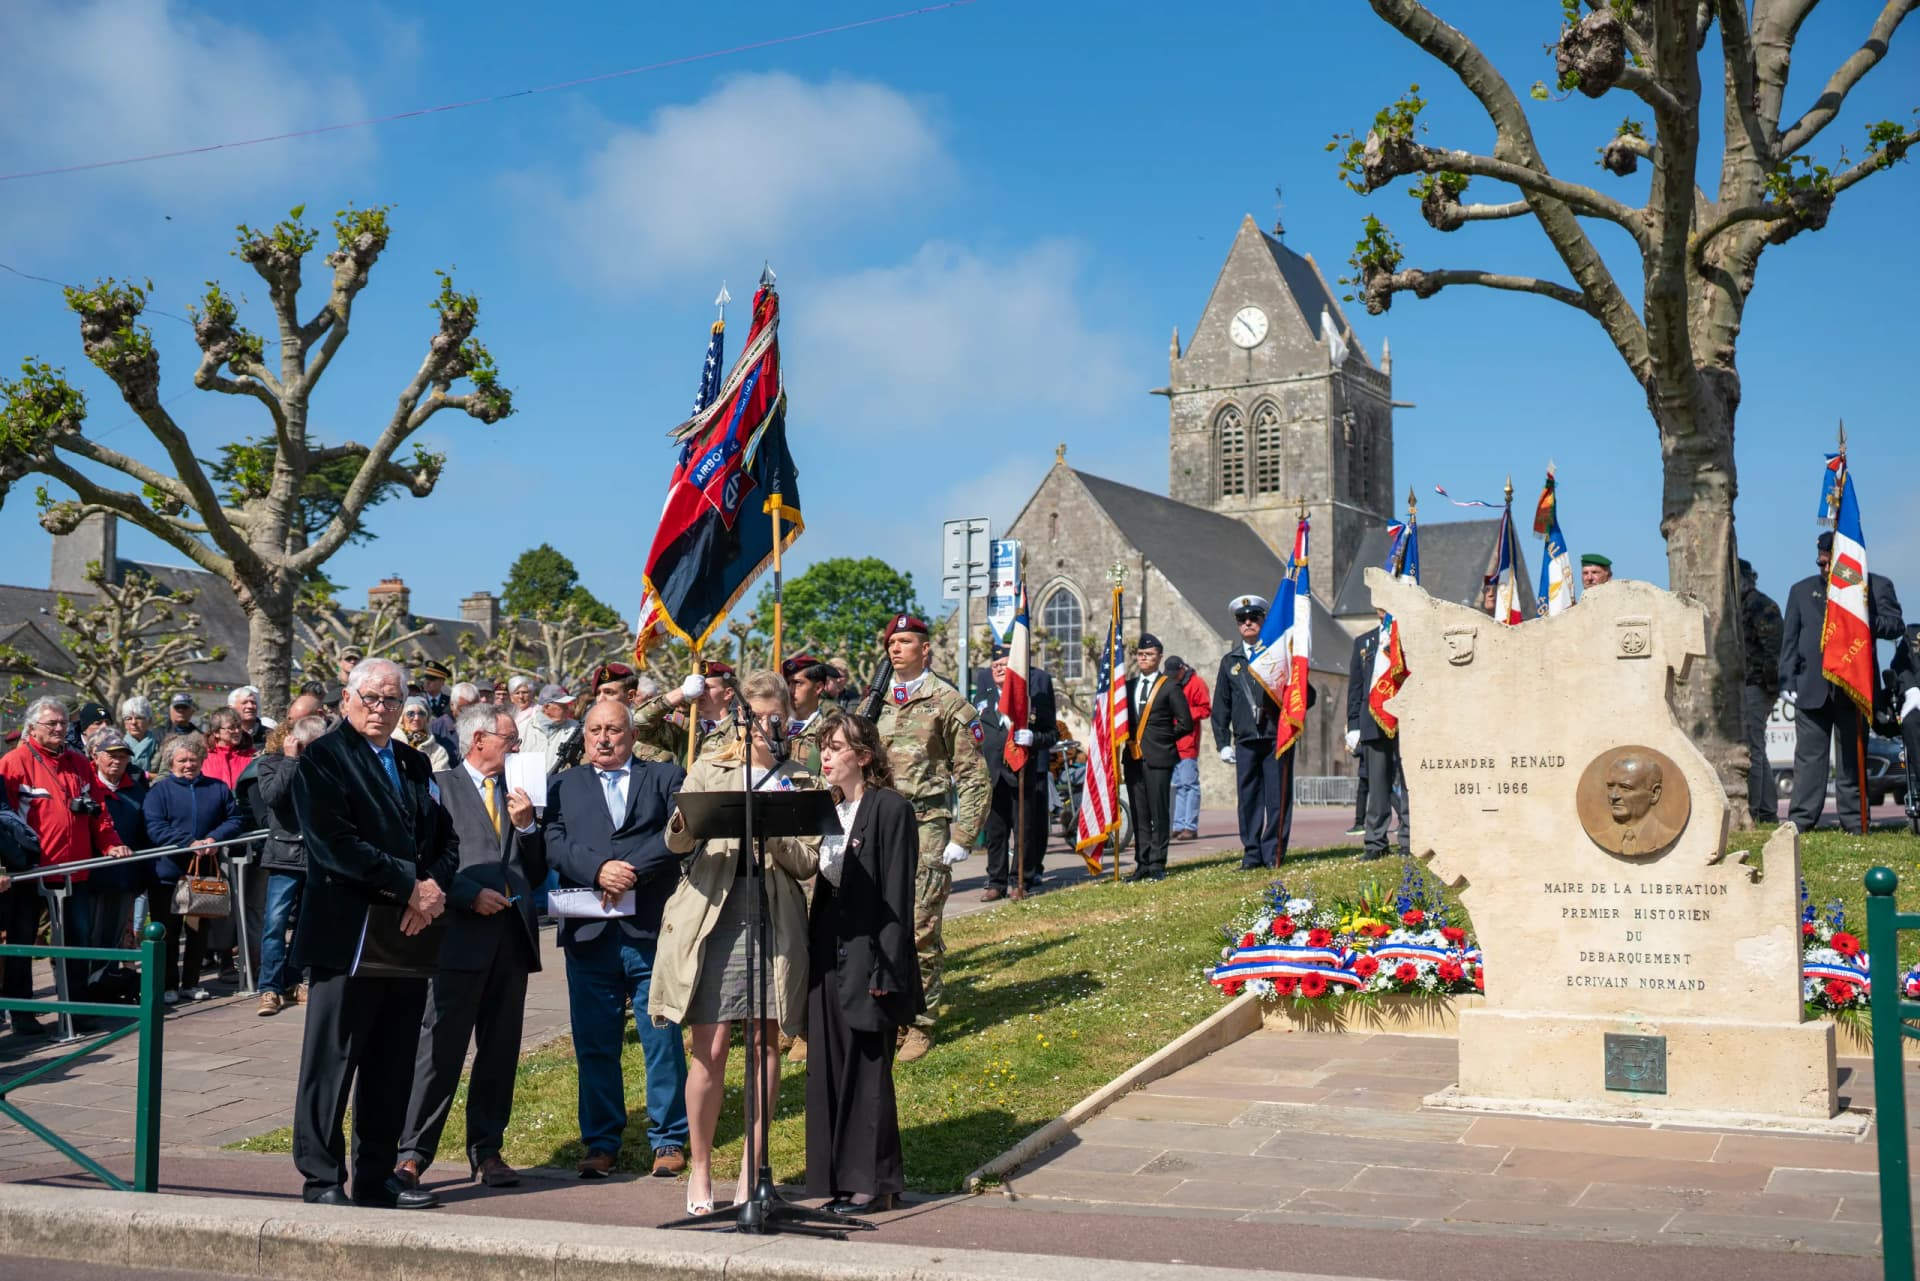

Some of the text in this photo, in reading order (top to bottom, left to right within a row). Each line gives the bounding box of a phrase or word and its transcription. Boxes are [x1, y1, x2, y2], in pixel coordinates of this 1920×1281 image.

[1420, 755, 1565, 769] ALEXANDRE RENAUD
[1454, 782, 1481, 795] 1891
[1497, 782, 1529, 794] 1966
[1544, 882, 1728, 895] MAIRE DE LA LIBERATION
[1562, 907, 1711, 921] PREMIER HISTORIEN
[1626, 931, 1642, 942] DU
[1579, 951, 1691, 965] DEBARQUEMENT
[1567, 976, 1705, 991] ECRIVAIN NORMAND
